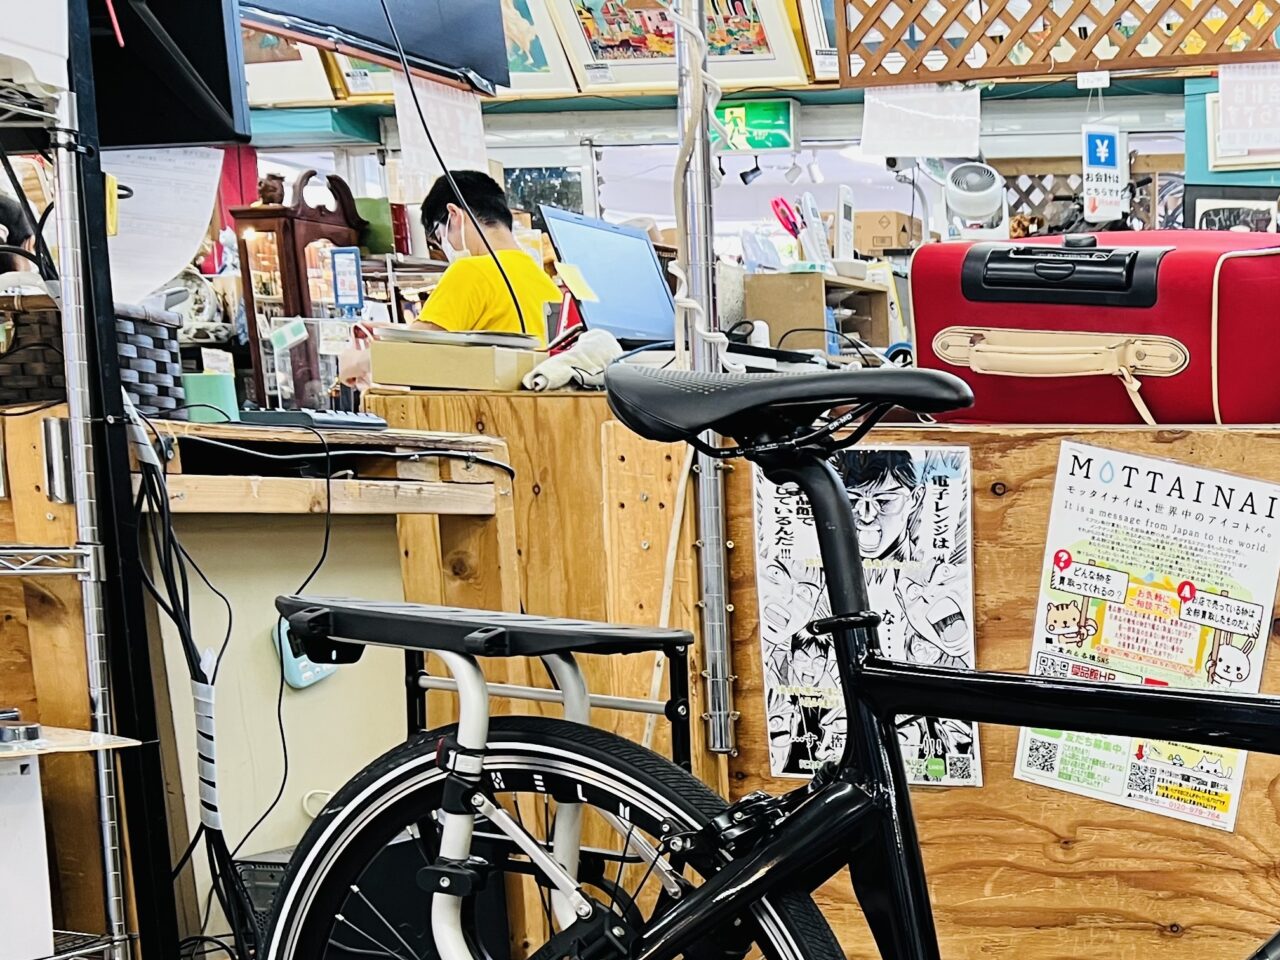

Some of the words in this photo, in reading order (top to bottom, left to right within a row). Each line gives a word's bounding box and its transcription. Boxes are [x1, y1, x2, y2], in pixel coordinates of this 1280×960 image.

[932, 474, 950, 550] 電子レンジは
[1064, 500, 1074, 510] It
[1076, 503, 1086, 512] is
[1089, 507, 1095, 515] a
[1099, 510, 1141, 525] message
[1145, 518, 1168, 531] from
[1173, 524, 1200, 539] Japan
[1205, 531, 1214, 540] to
[1219, 534, 1233, 545] the
[1073, 567, 1113, 586] どんな物を
